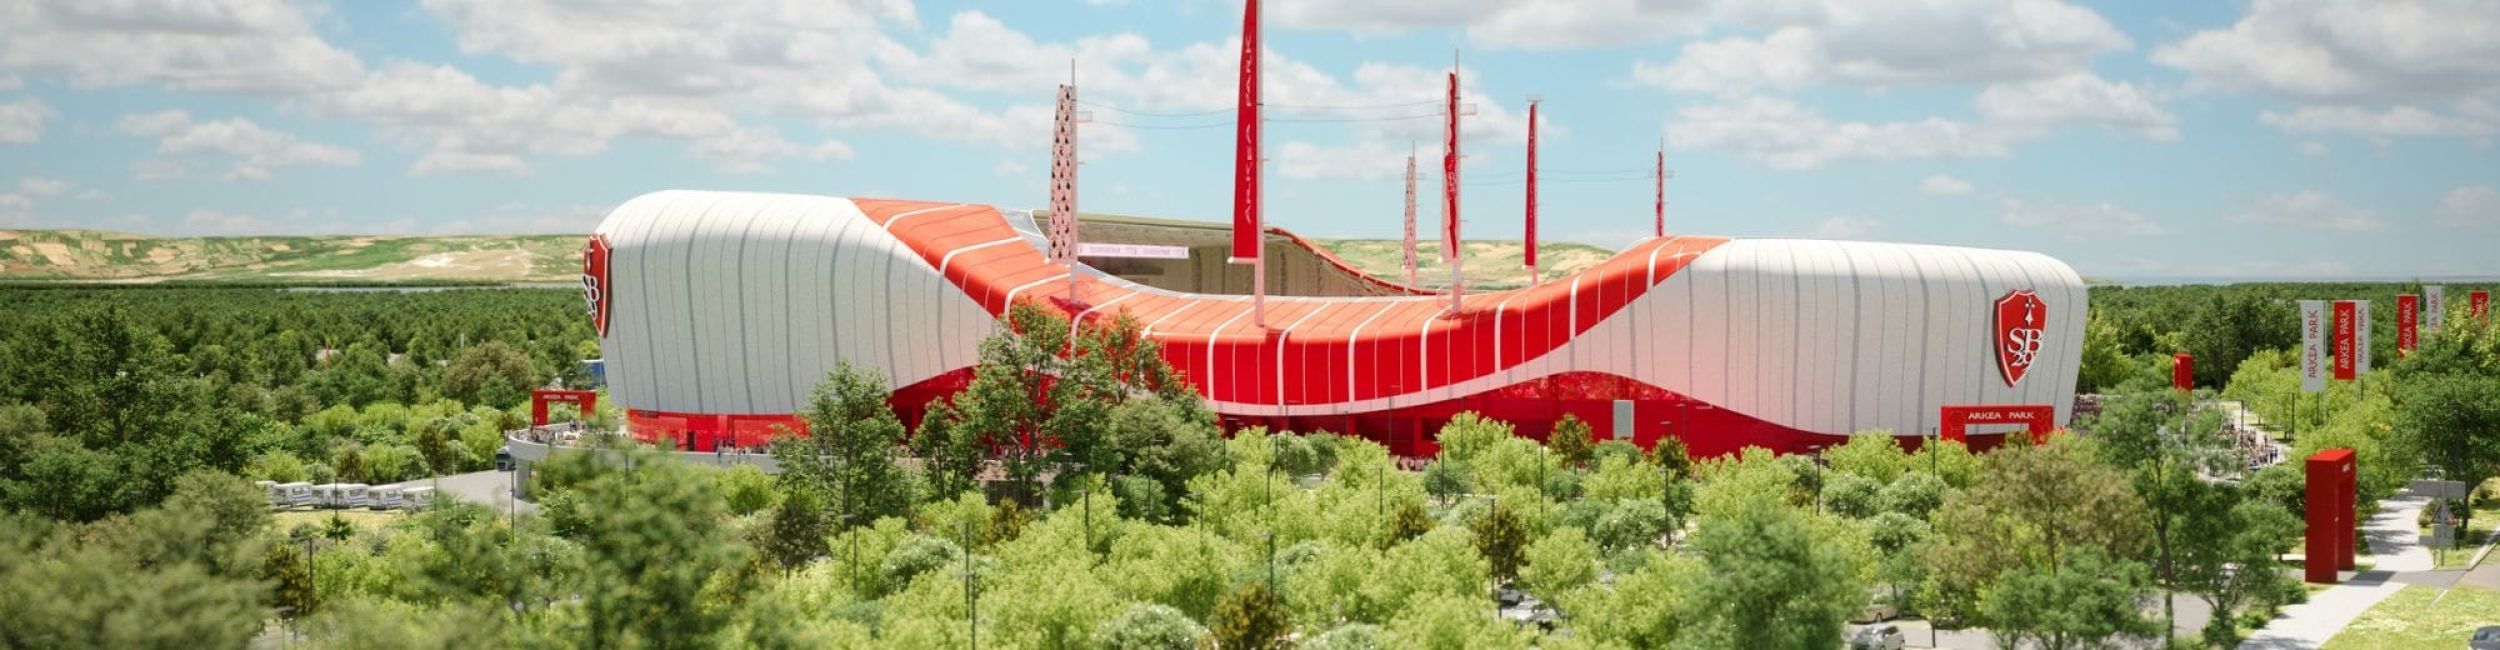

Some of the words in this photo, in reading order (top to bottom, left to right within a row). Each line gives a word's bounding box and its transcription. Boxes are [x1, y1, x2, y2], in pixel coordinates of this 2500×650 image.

[1244, 123, 1253, 225] ARKEA
[2307, 309, 2319, 339] PARK
[2339, 309, 2350, 335] PARK
[2403, 300, 2412, 322] PARK
[2007, 328, 2042, 353] SB
[2339, 338, 2350, 370] ARKEA
[2308, 344, 2319, 378] ARKEA
[1968, 411, 2002, 420] ARKEA
[2008, 411, 2035, 419] PARK
